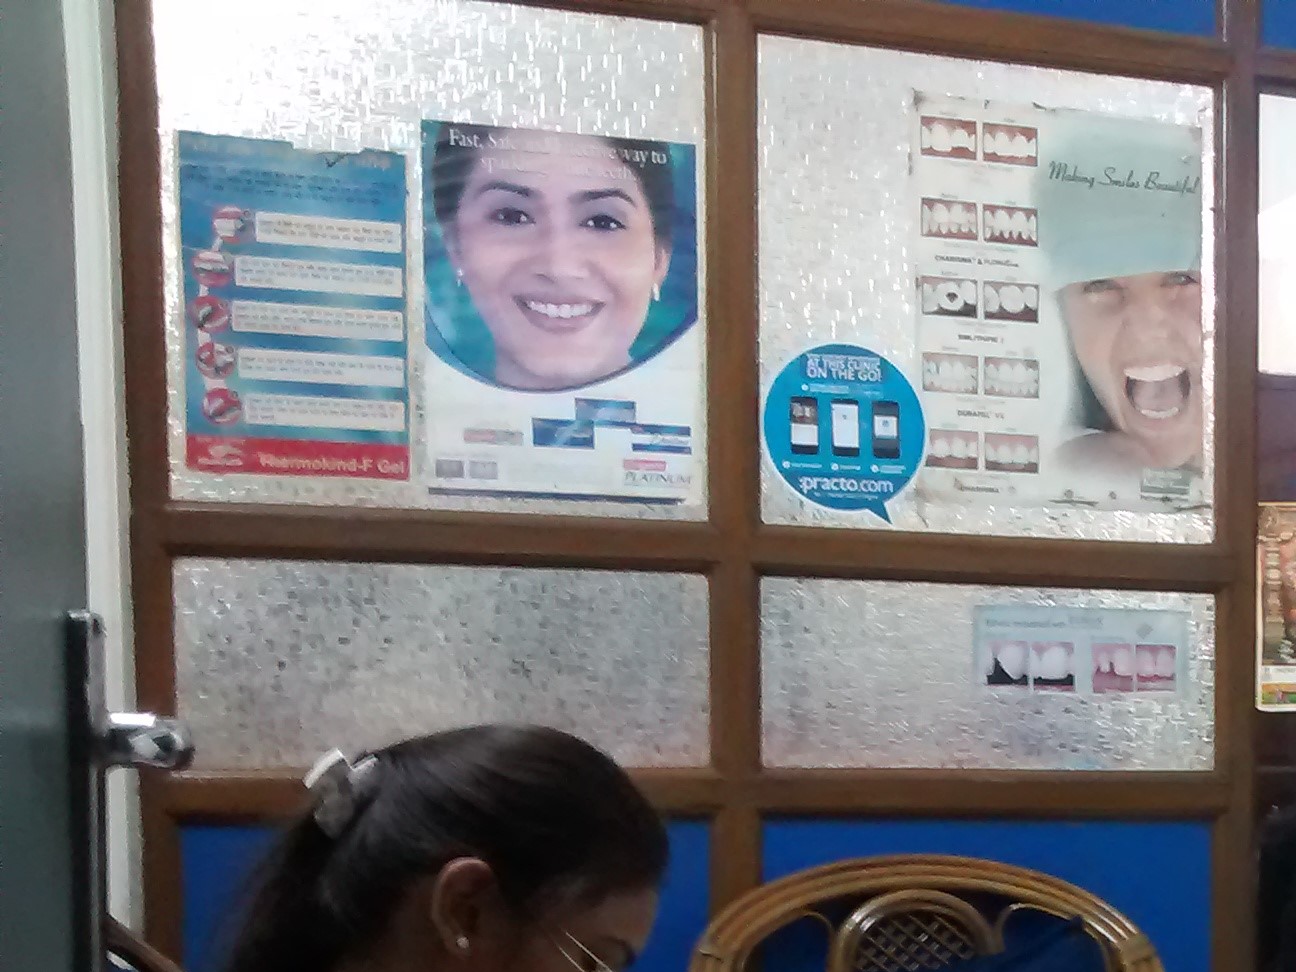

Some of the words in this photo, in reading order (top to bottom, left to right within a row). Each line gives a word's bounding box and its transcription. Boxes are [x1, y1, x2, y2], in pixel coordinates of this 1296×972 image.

[449, 128, 483, 150] Fast,
[651, 151, 668, 165] to
[806, 367, 827, 379] ON
[831, 368, 855, 381] THE
[858, 369, 882, 382] GO!
